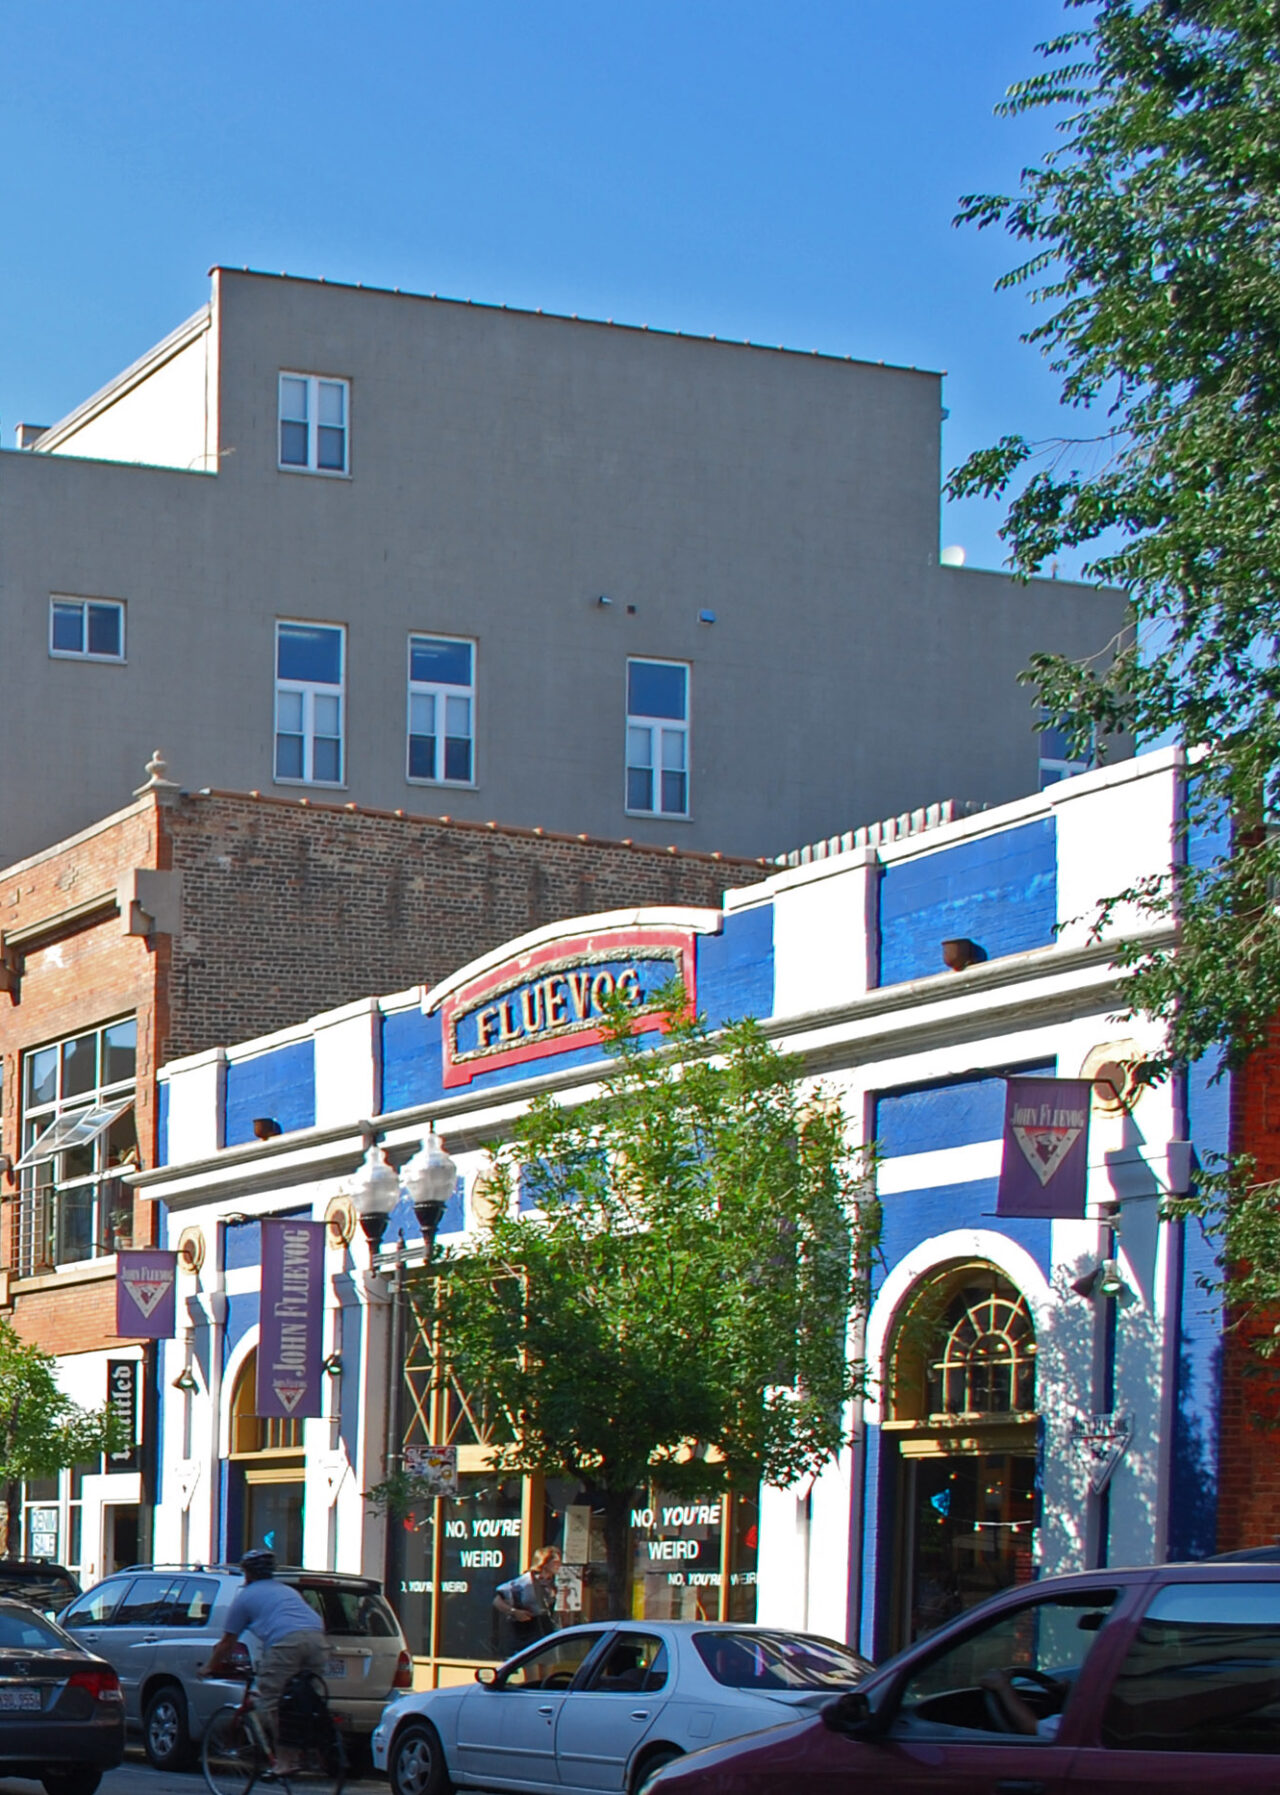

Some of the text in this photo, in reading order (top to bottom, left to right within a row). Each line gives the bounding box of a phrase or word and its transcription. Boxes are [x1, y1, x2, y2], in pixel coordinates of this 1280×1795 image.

[475, 968, 643, 1047] FLUEVOG
[1011, 1102, 1085, 1127] JOHN FLUEVOG
[274, 1228, 311, 1318] FLUEVOG
[272, 1322, 307, 1377] JOHN
[630, 1504, 722, 1529] NO, YOU'RE
[445, 1518, 522, 1540] NO, YOU'RE
[460, 1550, 504, 1568] WEIRD
[648, 1540, 700, 1560] WEIRD
[441, 1581, 468, 1593] WEIRD
[667, 1573, 686, 1587] NO,
